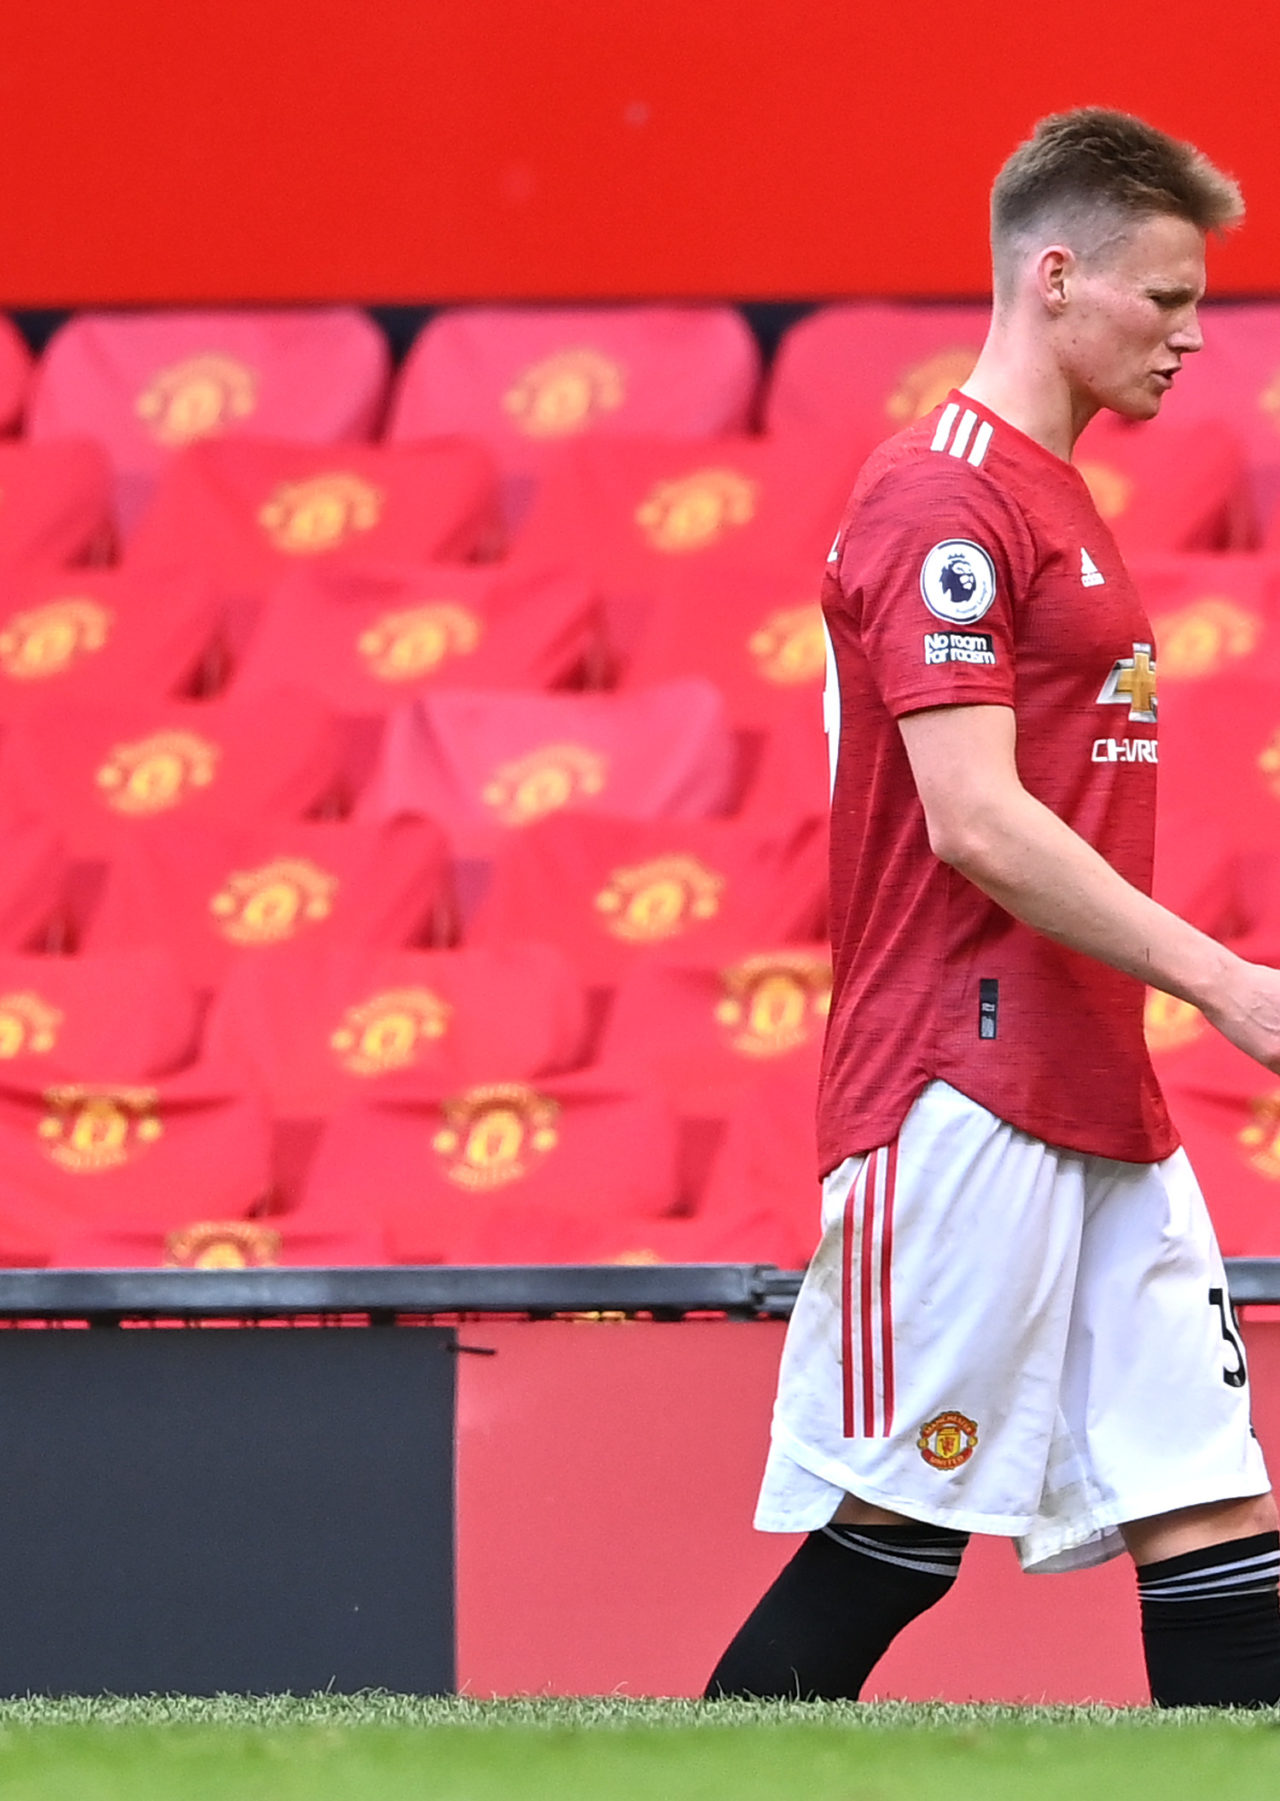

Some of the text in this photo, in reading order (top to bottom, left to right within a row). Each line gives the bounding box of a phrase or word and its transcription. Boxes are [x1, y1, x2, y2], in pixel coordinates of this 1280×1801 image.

[924, 633, 987, 651] No room
[949, 648, 996, 665] racism
